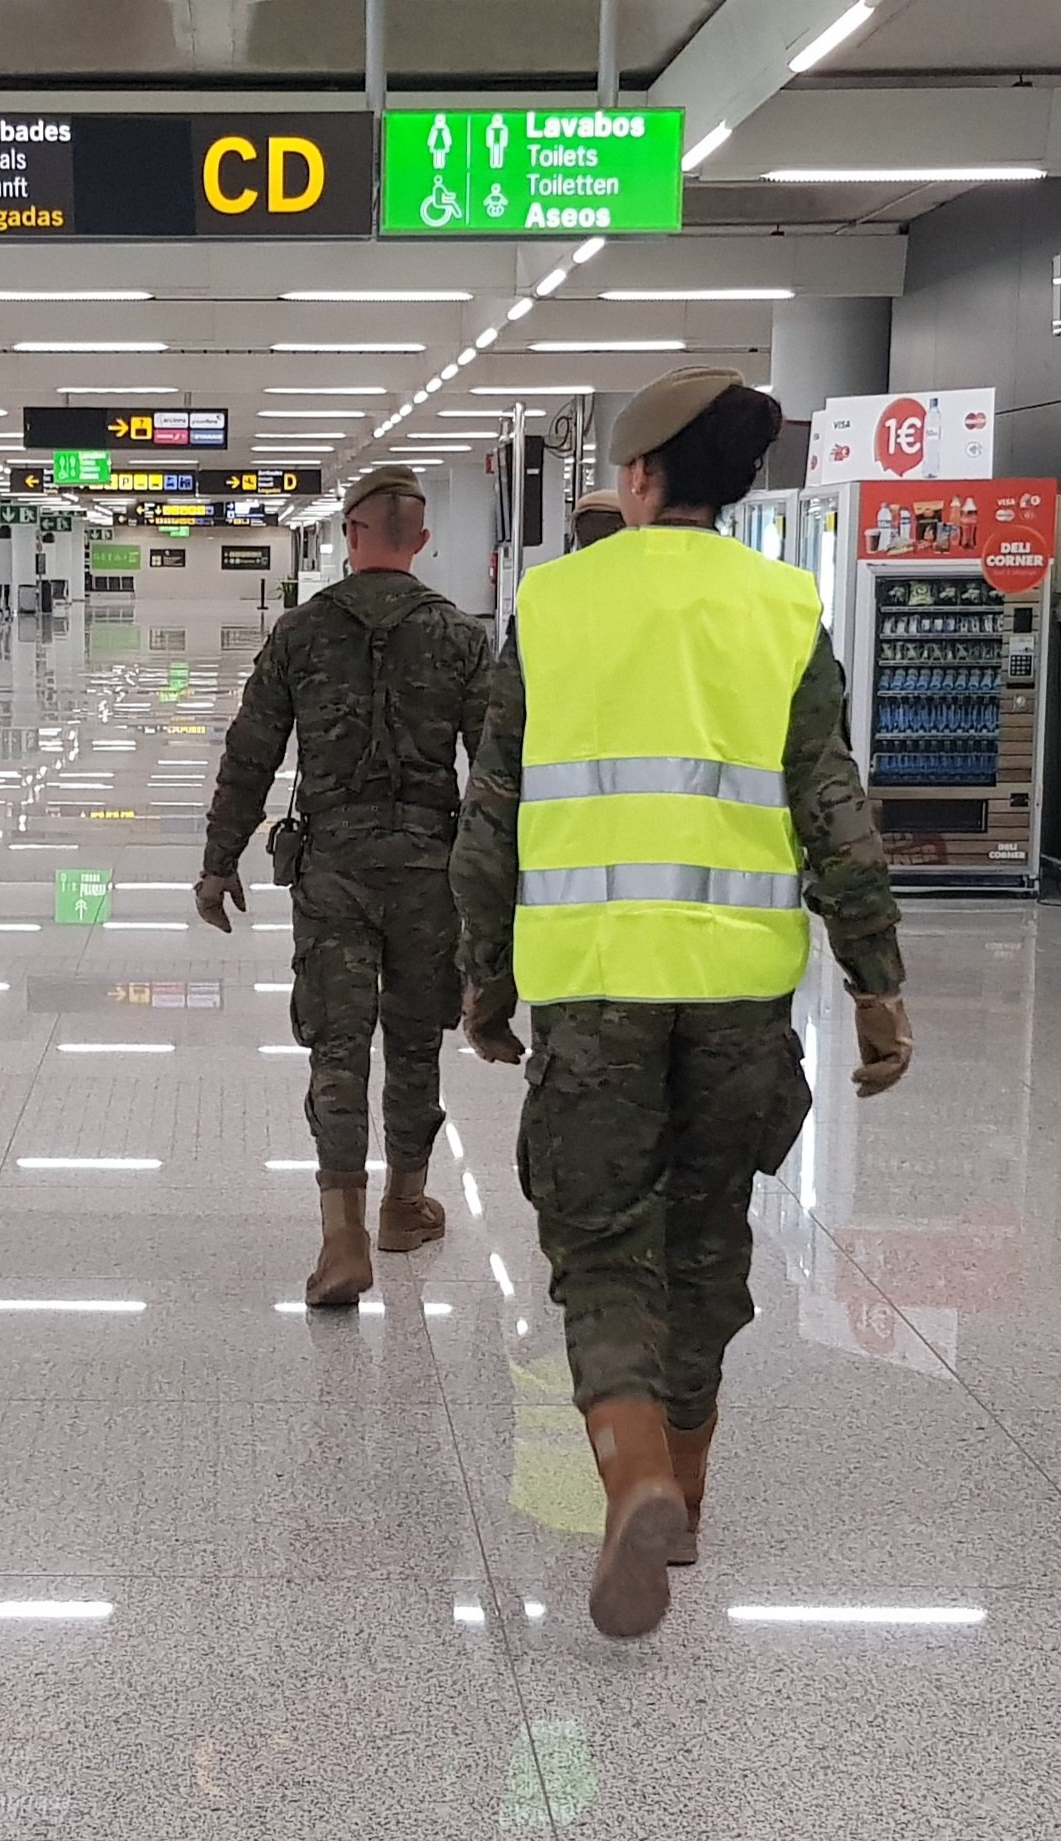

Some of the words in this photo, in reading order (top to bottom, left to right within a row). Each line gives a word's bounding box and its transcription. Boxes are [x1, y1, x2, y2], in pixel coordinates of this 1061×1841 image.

[525, 111, 645, 138] Lavabos
[526, 144, 598, 167] Toilets
[202, 136, 326, 214] CD
[526, 174, 619, 196] Toiletten
[524, 202, 611, 228] Aseos
[885, 416, 922, 455] 1€
[283, 473, 297, 491] D
[1000, 542, 1031, 554] DELI
[986, 554, 1043, 567] CORNER
